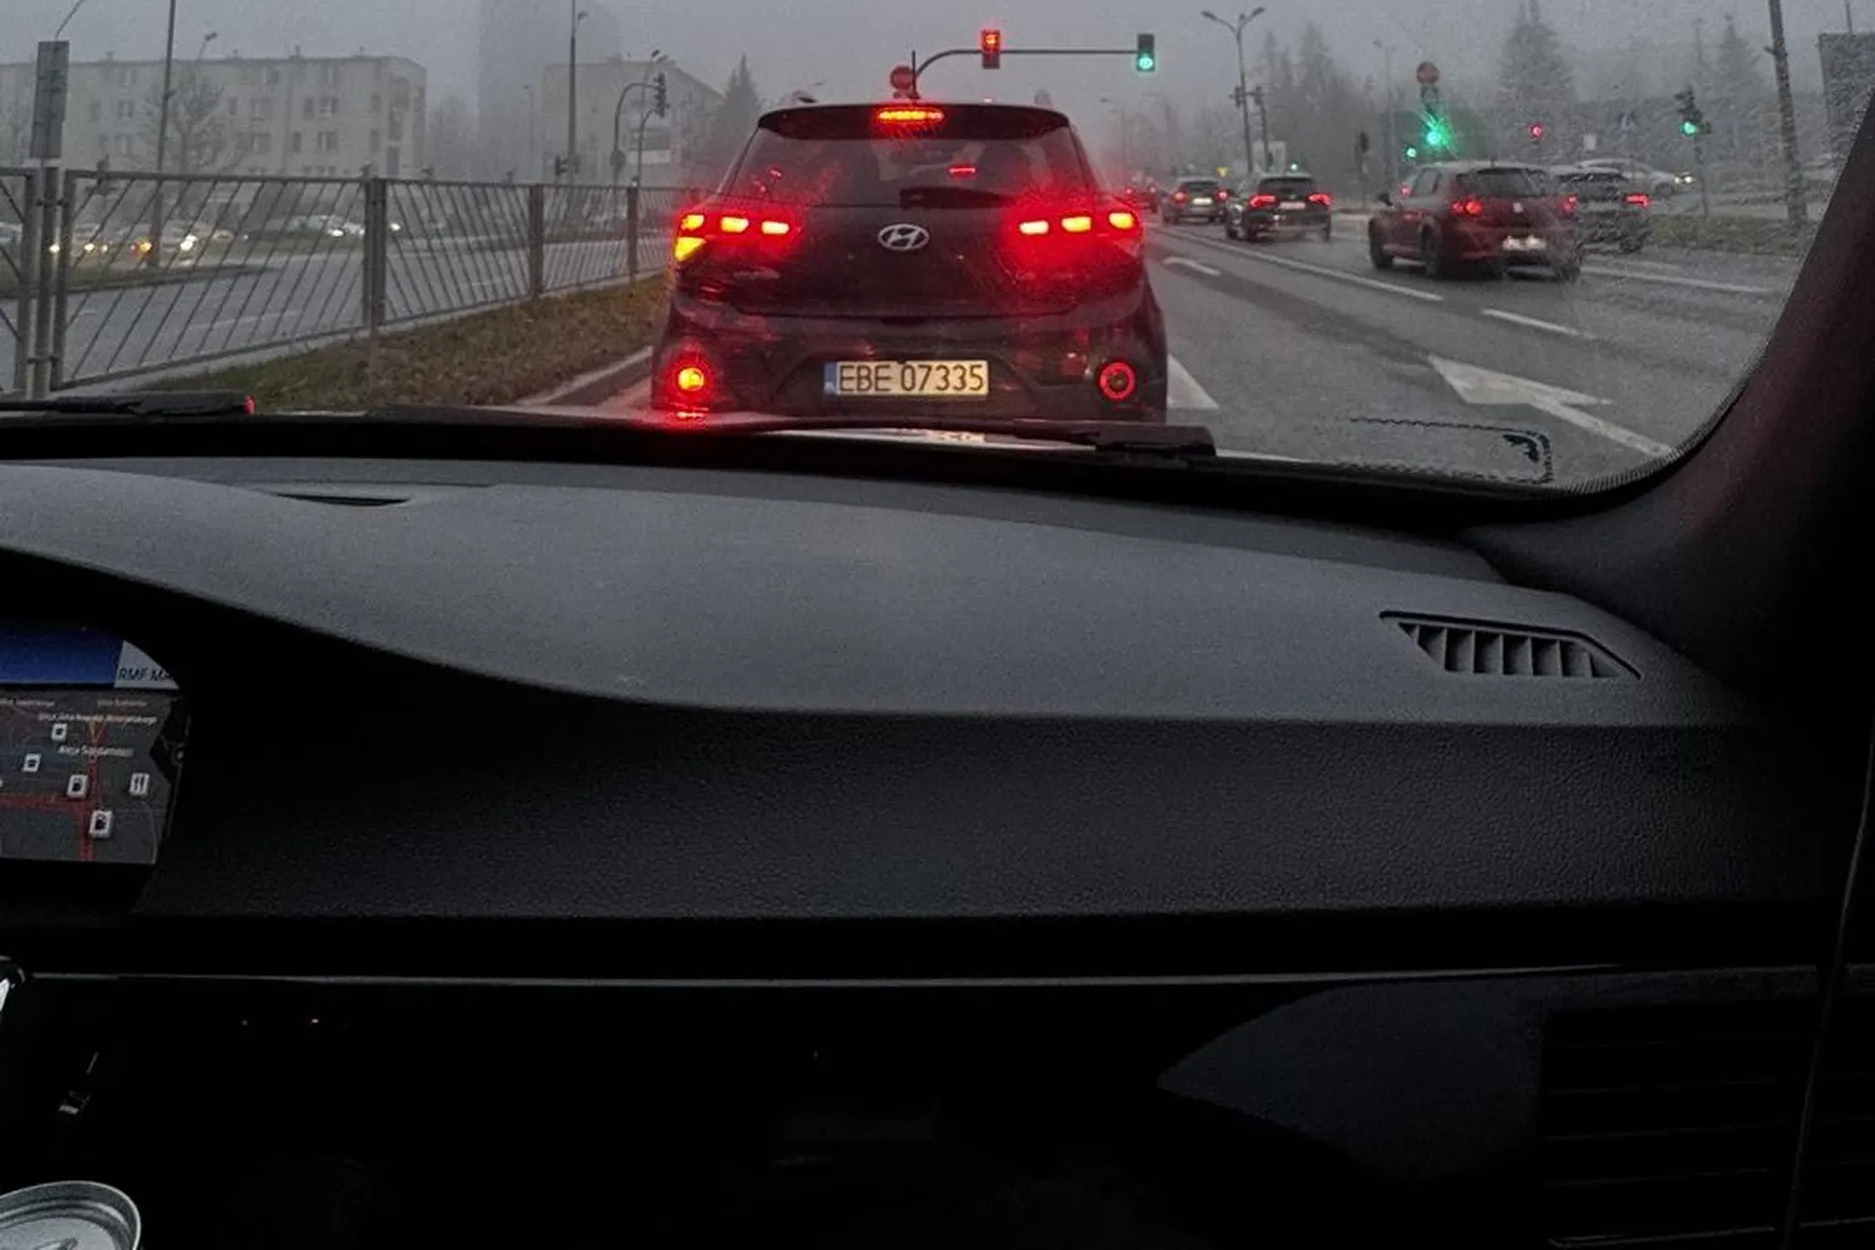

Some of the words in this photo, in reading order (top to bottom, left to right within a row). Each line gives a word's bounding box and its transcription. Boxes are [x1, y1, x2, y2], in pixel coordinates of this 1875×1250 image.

[839, 364, 892, 392] EBE
[899, 364, 984, 392] 07335
[119, 667, 148, 681] RMF
